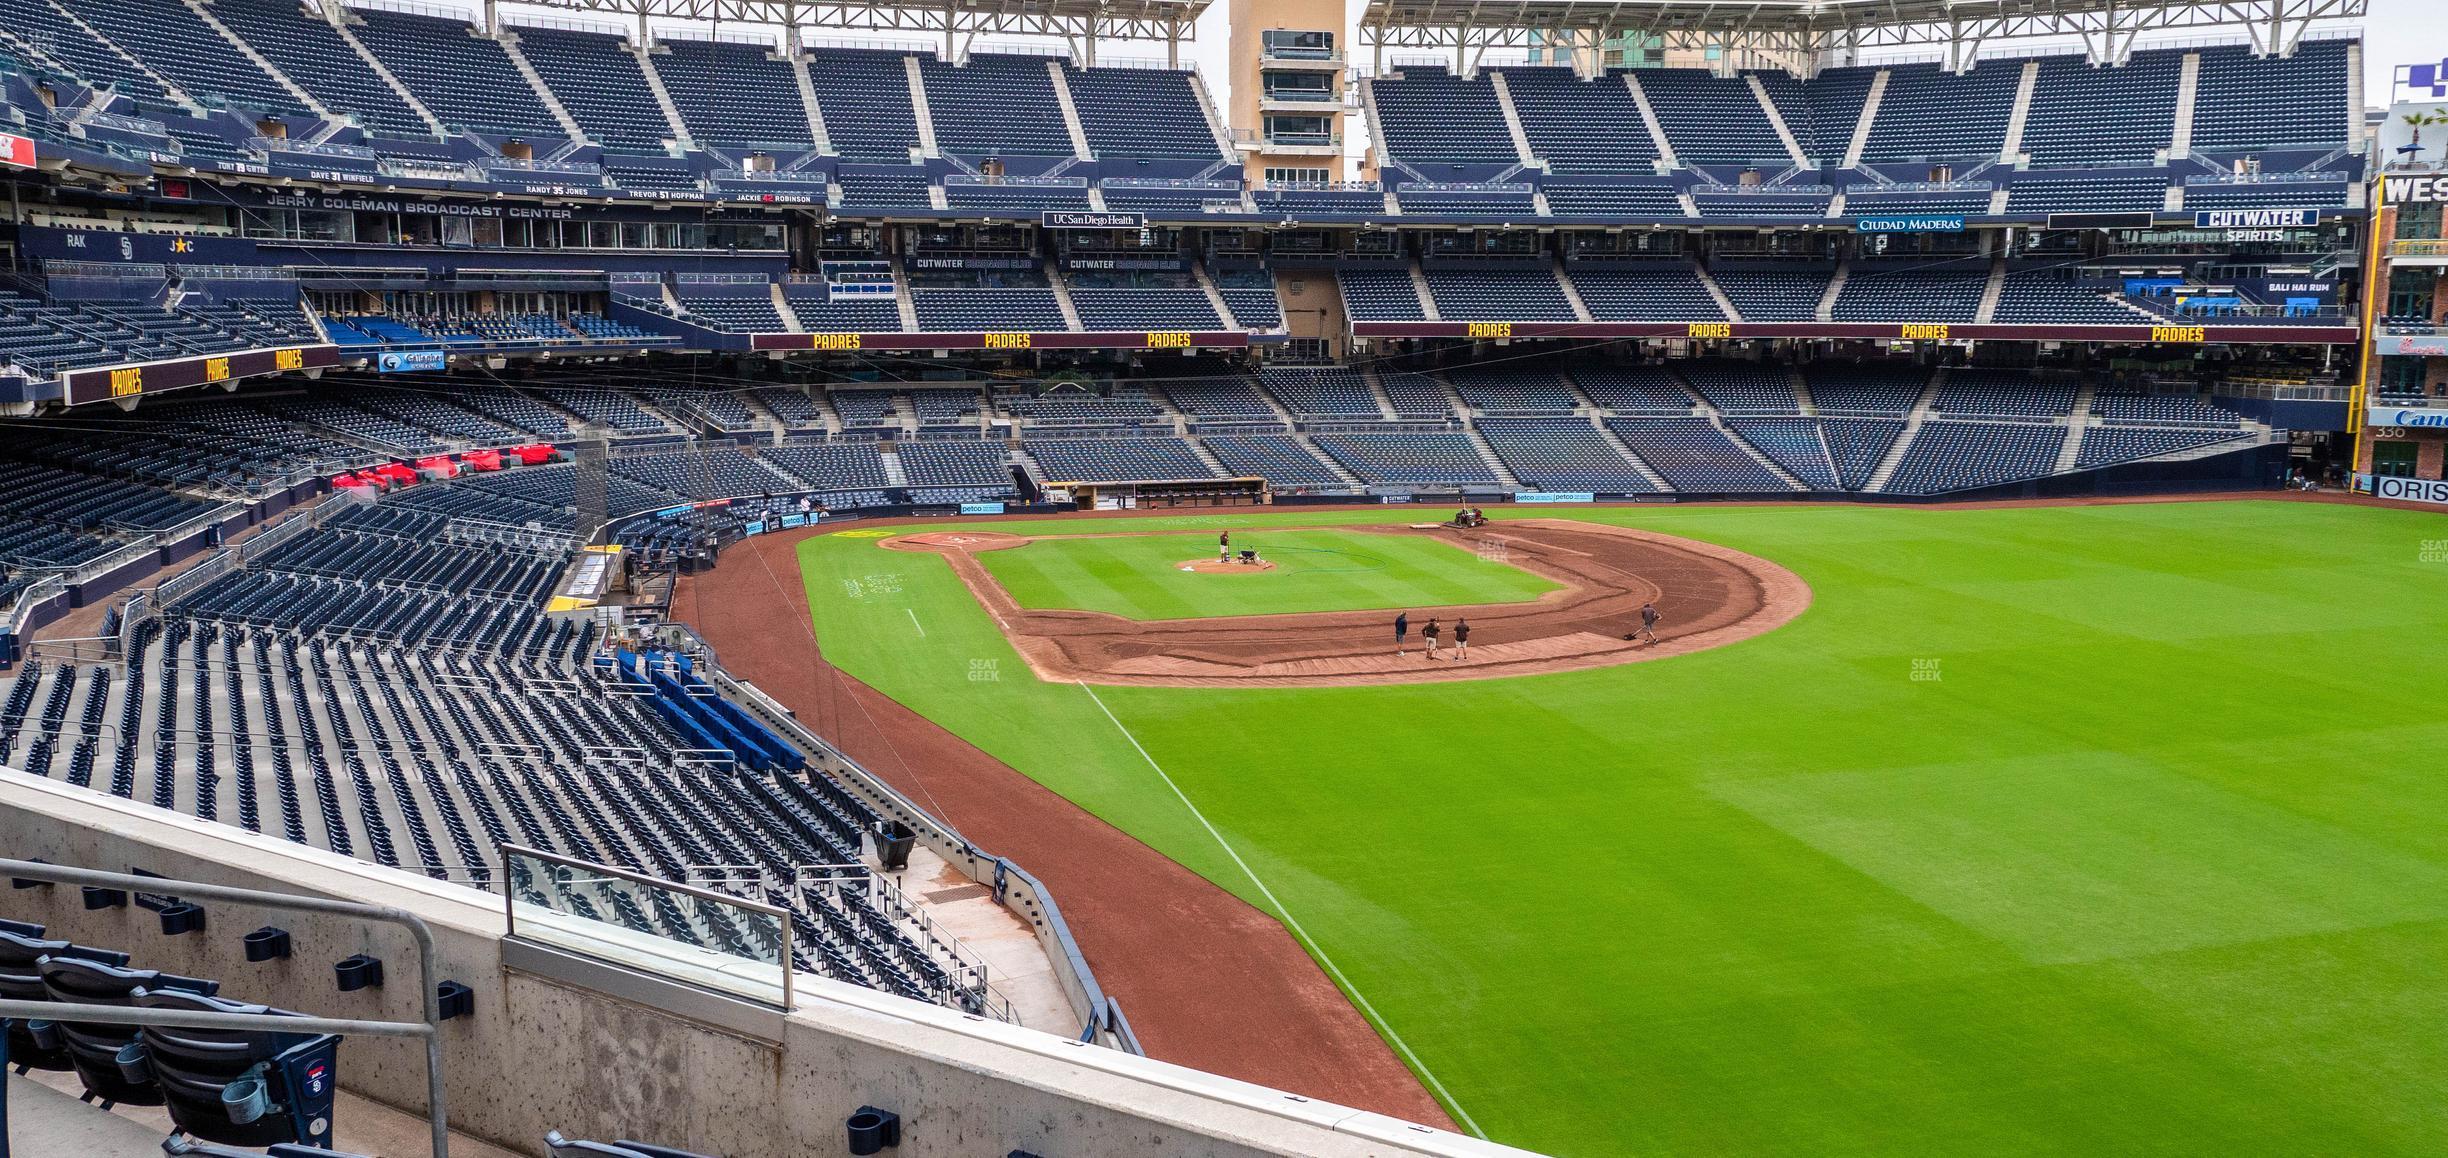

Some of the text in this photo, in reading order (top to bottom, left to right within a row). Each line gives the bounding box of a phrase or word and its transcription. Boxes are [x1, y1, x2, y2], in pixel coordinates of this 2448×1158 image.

[311, 171, 374, 183] DAVE 31 WINFIELD
[526, 186, 588, 196] RANDY 35 JONES
[629, 190, 705, 200] TREVOR 51 HOFFMAN
[737, 194, 761, 202] JACKIE
[763, 194, 774, 203] 42
[267, 194, 573, 219] JERRY COLEMAN BROADCAST CENTER
[1054, 214, 1135, 227] UC San Diego Health
[2208, 210, 2305, 227] CUTWATER
[67, 234, 87, 248] RAK
[2226, 230, 2284, 242] SPIRITS
[917, 259, 963, 268] CUTWATER
[1070, 260, 1114, 269] CUTWATER
[2268, 283, 2330, 292] BALI HAI RUM
[1468, 323, 1511, 337] PADRES
[1688, 323, 1731, 338] PADRES
[1901, 324, 1949, 339] PADRES
[2152, 327, 2205, 342] PADRES
[814, 334, 861, 349] PADRES
[985, 333, 1031, 348] PADRES
[1147, 332, 1192, 347] PADRES
[274, 349, 303, 370] PADRES
[206, 357, 230, 382] PADRES
[111, 368, 142, 397] PADRES
[2395, 410, 2448, 427] Can
